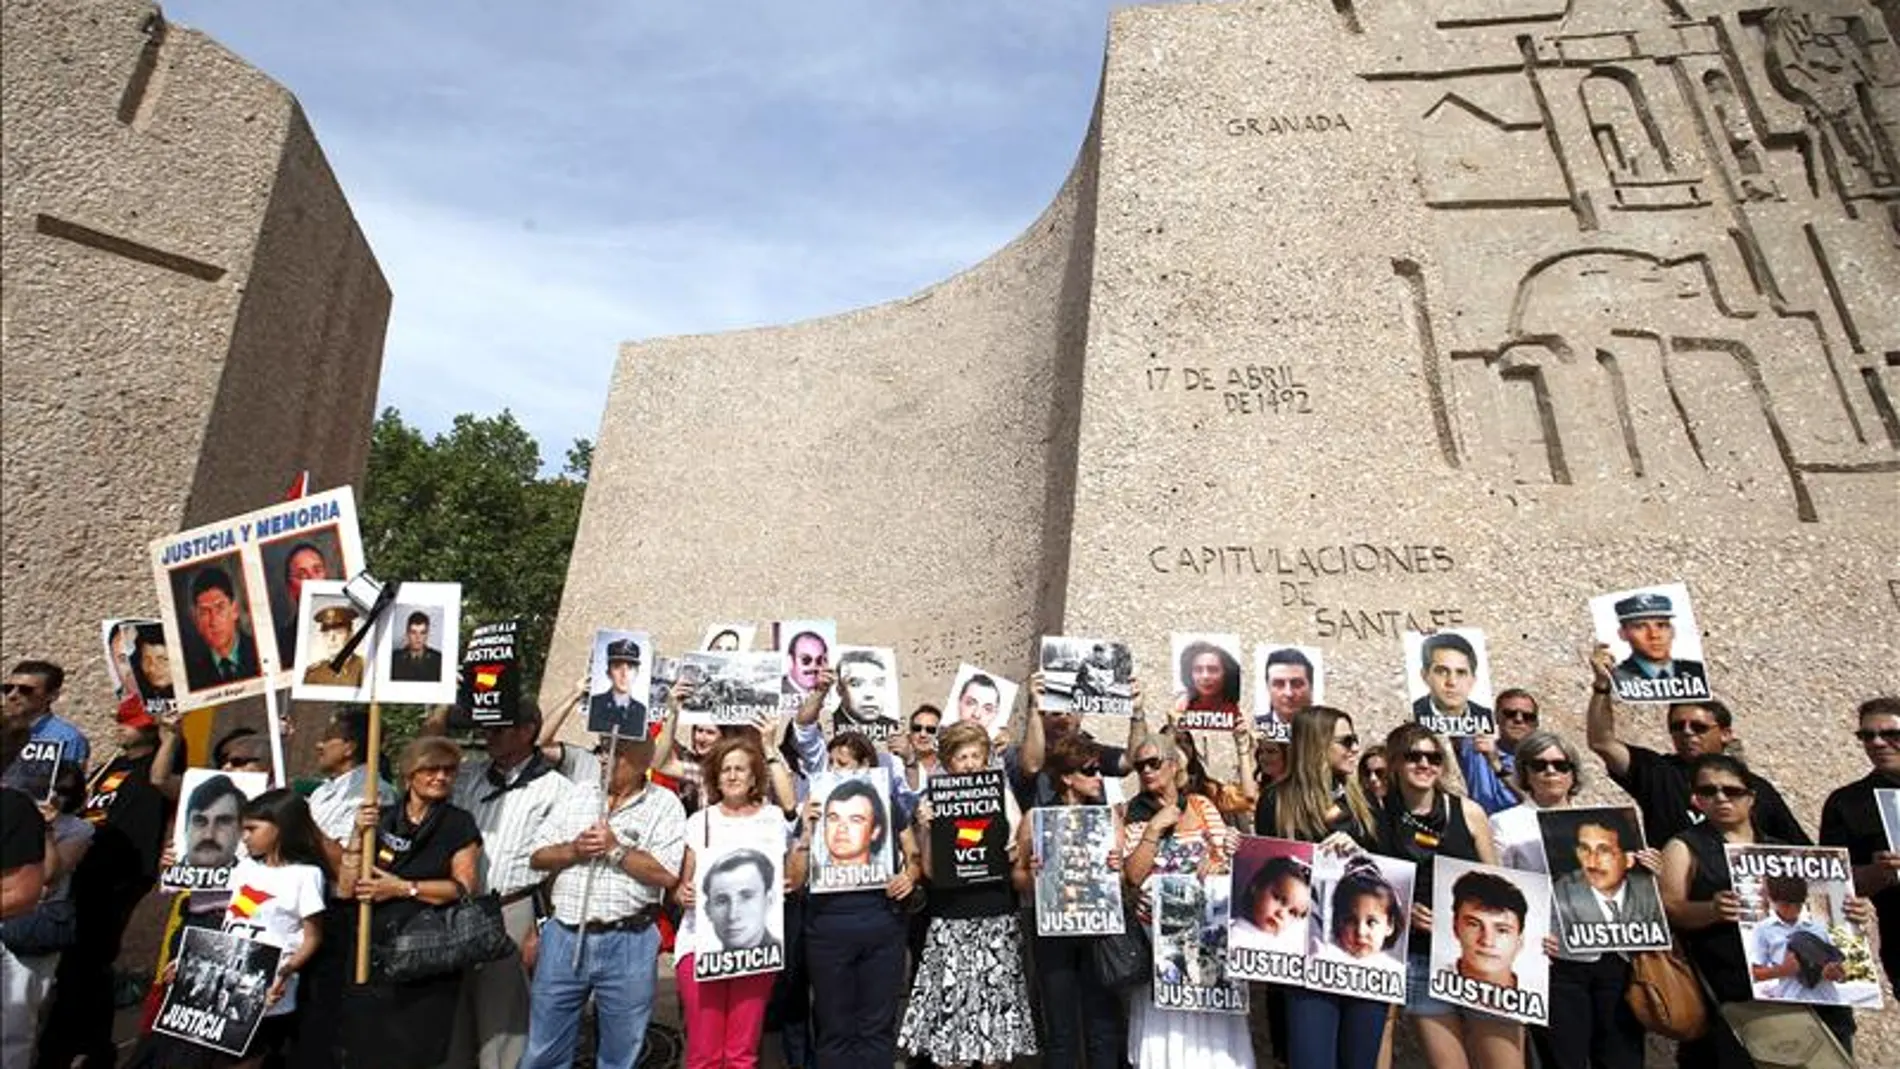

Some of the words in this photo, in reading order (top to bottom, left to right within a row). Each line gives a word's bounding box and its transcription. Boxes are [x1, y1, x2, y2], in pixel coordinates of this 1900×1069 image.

[1227, 113, 1352, 137] GRANADA
[1146, 368, 1171, 391] 17
[1184, 367, 1216, 391] DE
[1227, 364, 1306, 389] ABRIL
[1224, 391, 1252, 415] DE
[1256, 390, 1313, 415] 1492
[161, 530, 236, 566] JUSTICIA
[239, 524, 252, 542] Y
[255, 500, 341, 539] MEMORIA
[1149, 543, 1454, 576] CAPITULACIONES
[1279, 580, 1317, 607] DE
[1315, 607, 1424, 641] SANTA
[472, 690, 501, 706] VCT
[1619, 677, 1706, 698] JUSTICIA
[932, 776, 973, 788] FRENTE
[976, 775, 984, 785] A
[985, 773, 1000, 784] LA
[934, 799, 1001, 817] JUSTICIA
[955, 847, 987, 862] VCT
[1737, 854, 1846, 879] JUSTICIA
[162, 866, 229, 886] JUSTIC
[816, 863, 888, 887] JUSTICIA
[1042, 910, 1120, 932] JUSTICIA
[1568, 922, 1666, 948] JUSTICIA
[698, 946, 781, 977] JUSTICIA
[1229, 949, 1305, 980] JUSTIC
[1306, 959, 1403, 998] JUSTICIA
[1158, 983, 1243, 1010] JUSTICIA
[1433, 971, 1546, 1020] JUSTICIA
[162, 1003, 227, 1043] JUSTICIA
